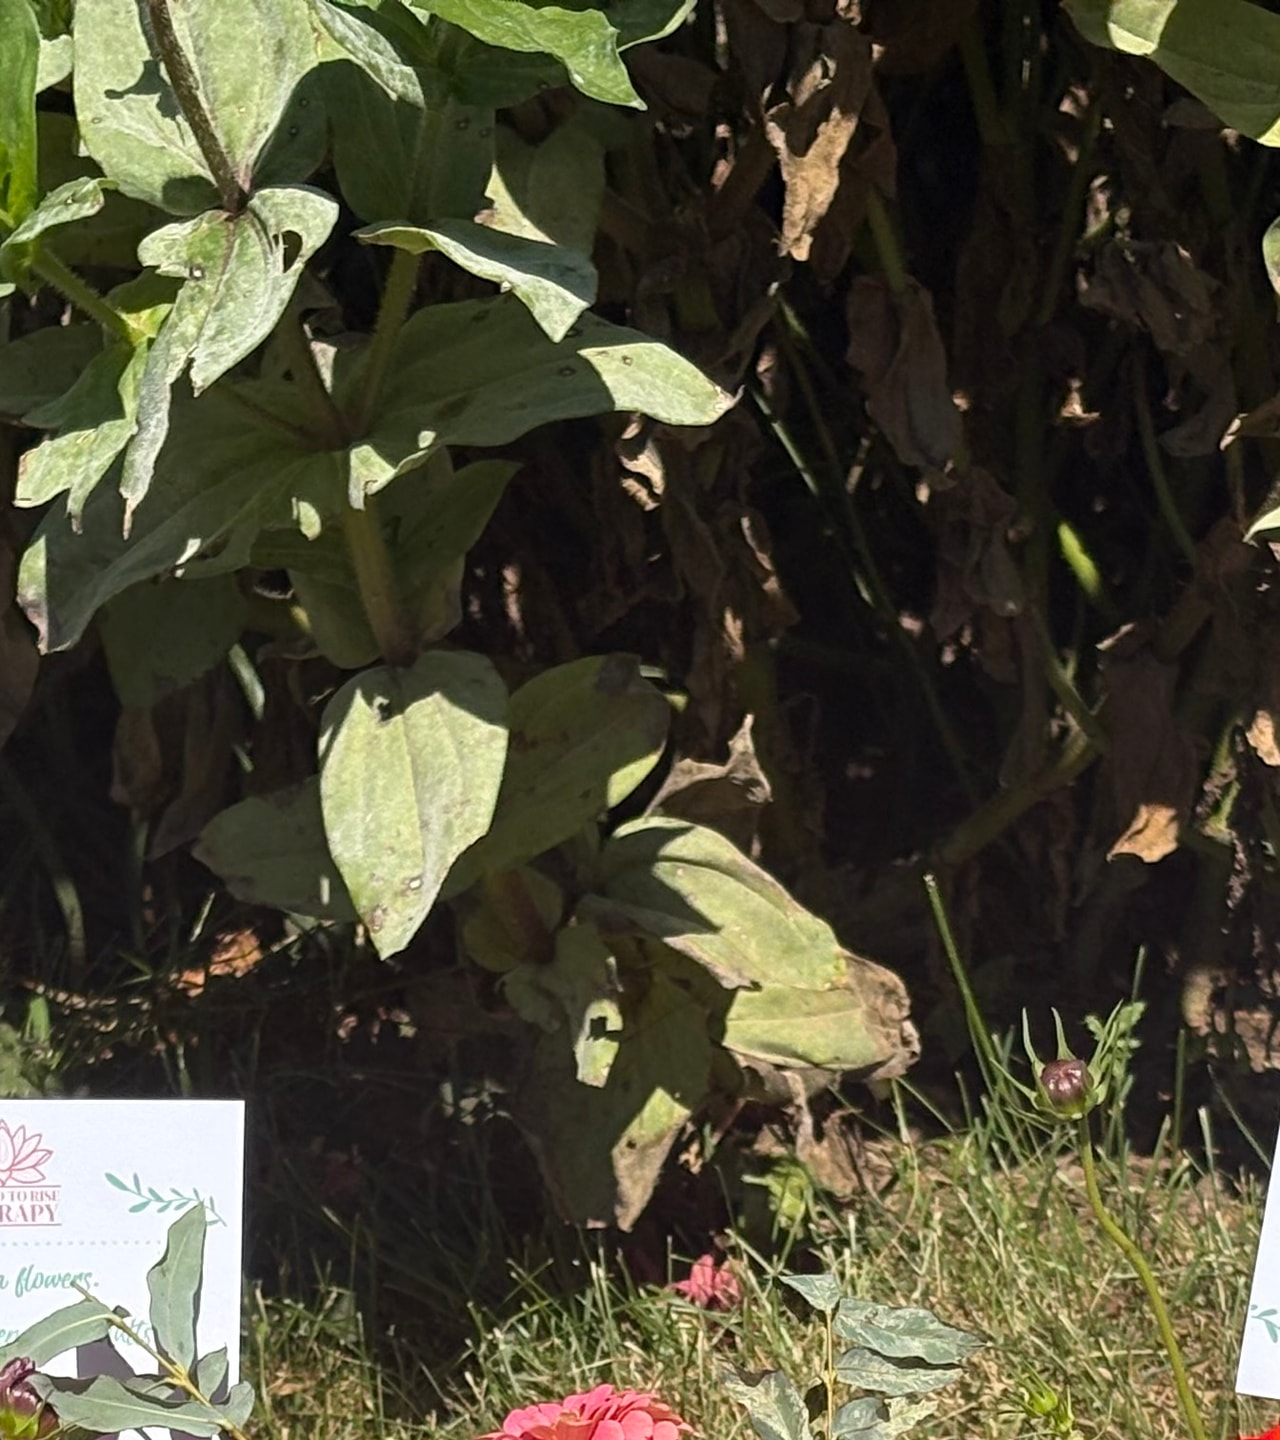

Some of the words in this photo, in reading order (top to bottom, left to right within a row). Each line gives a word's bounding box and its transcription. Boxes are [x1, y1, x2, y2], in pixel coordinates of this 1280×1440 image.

[9, 1191, 28, 1203] TO
[30, 1190, 60, 1202] RISE
[14, 1264, 99, 1298] flowers.
